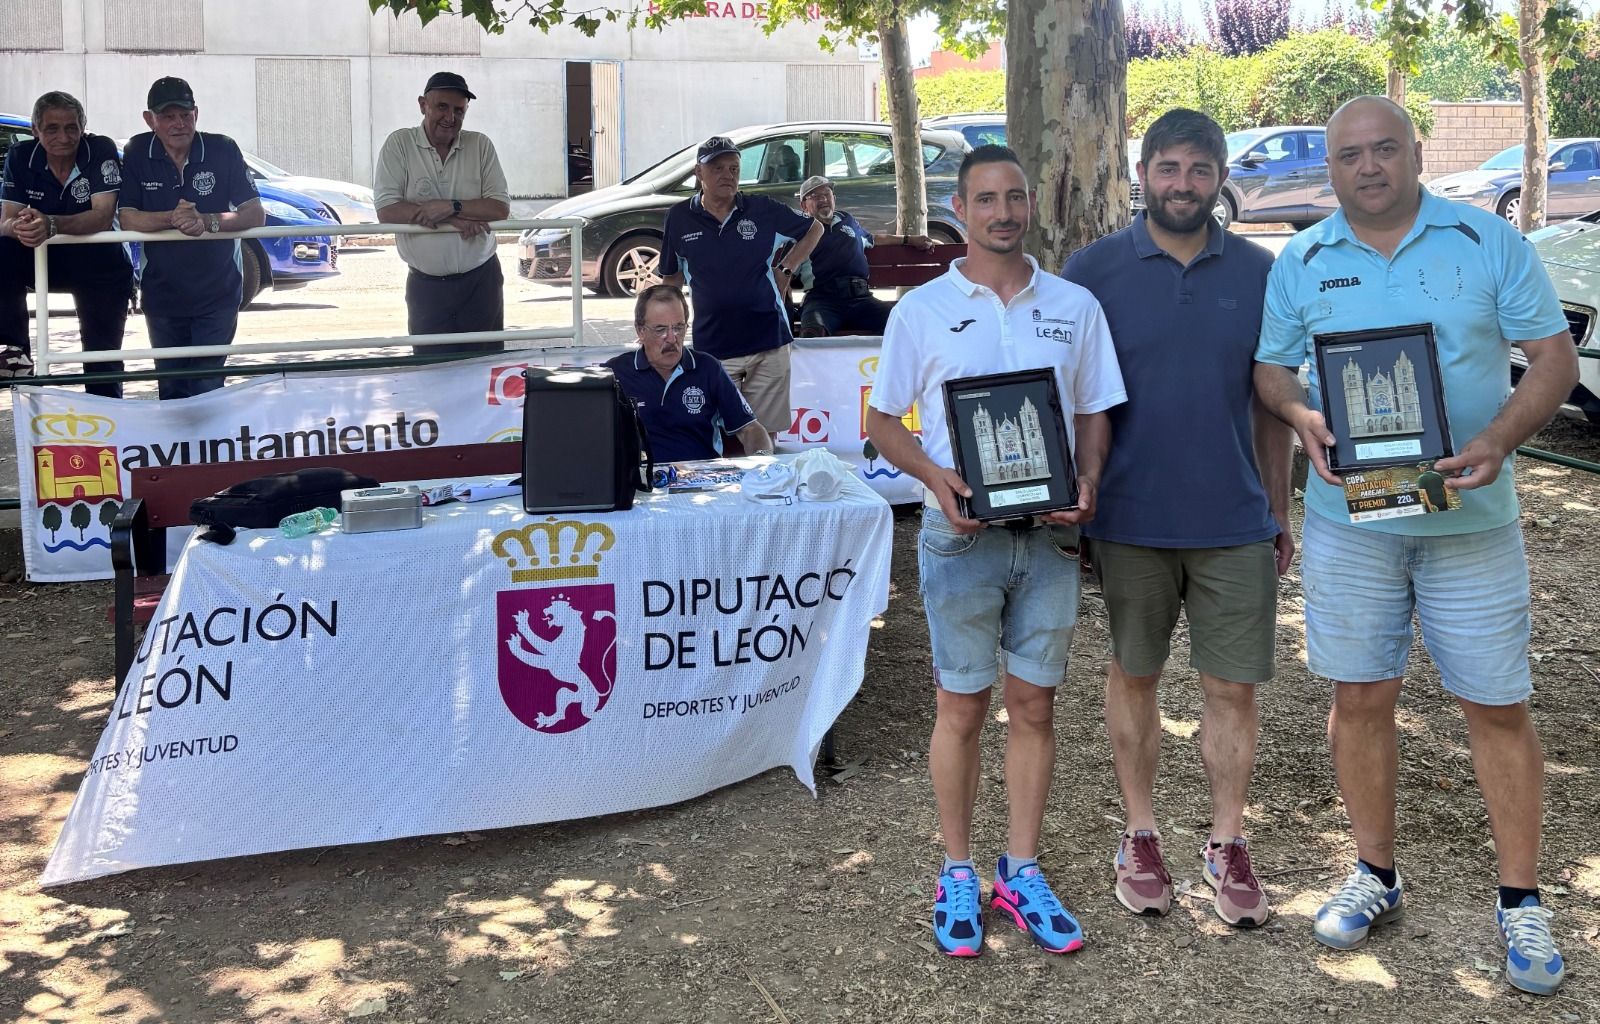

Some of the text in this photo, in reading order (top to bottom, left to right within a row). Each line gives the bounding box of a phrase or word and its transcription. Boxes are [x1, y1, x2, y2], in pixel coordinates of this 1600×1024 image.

[122, 411, 439, 471] ayuntamiento
[1346, 475, 1366, 485] COPA
[1359, 498, 1387, 509] PREMIO
[643, 559, 857, 617] DIPUTACIÓ
[644, 614, 813, 670] DE LEÓN
[118, 655, 233, 721] LEÓN
[643, 675, 801, 719] DEPORTES Y JUVENTUD
[125, 748, 135, 765] Y
[136, 734, 239, 769] JUVENTUD
